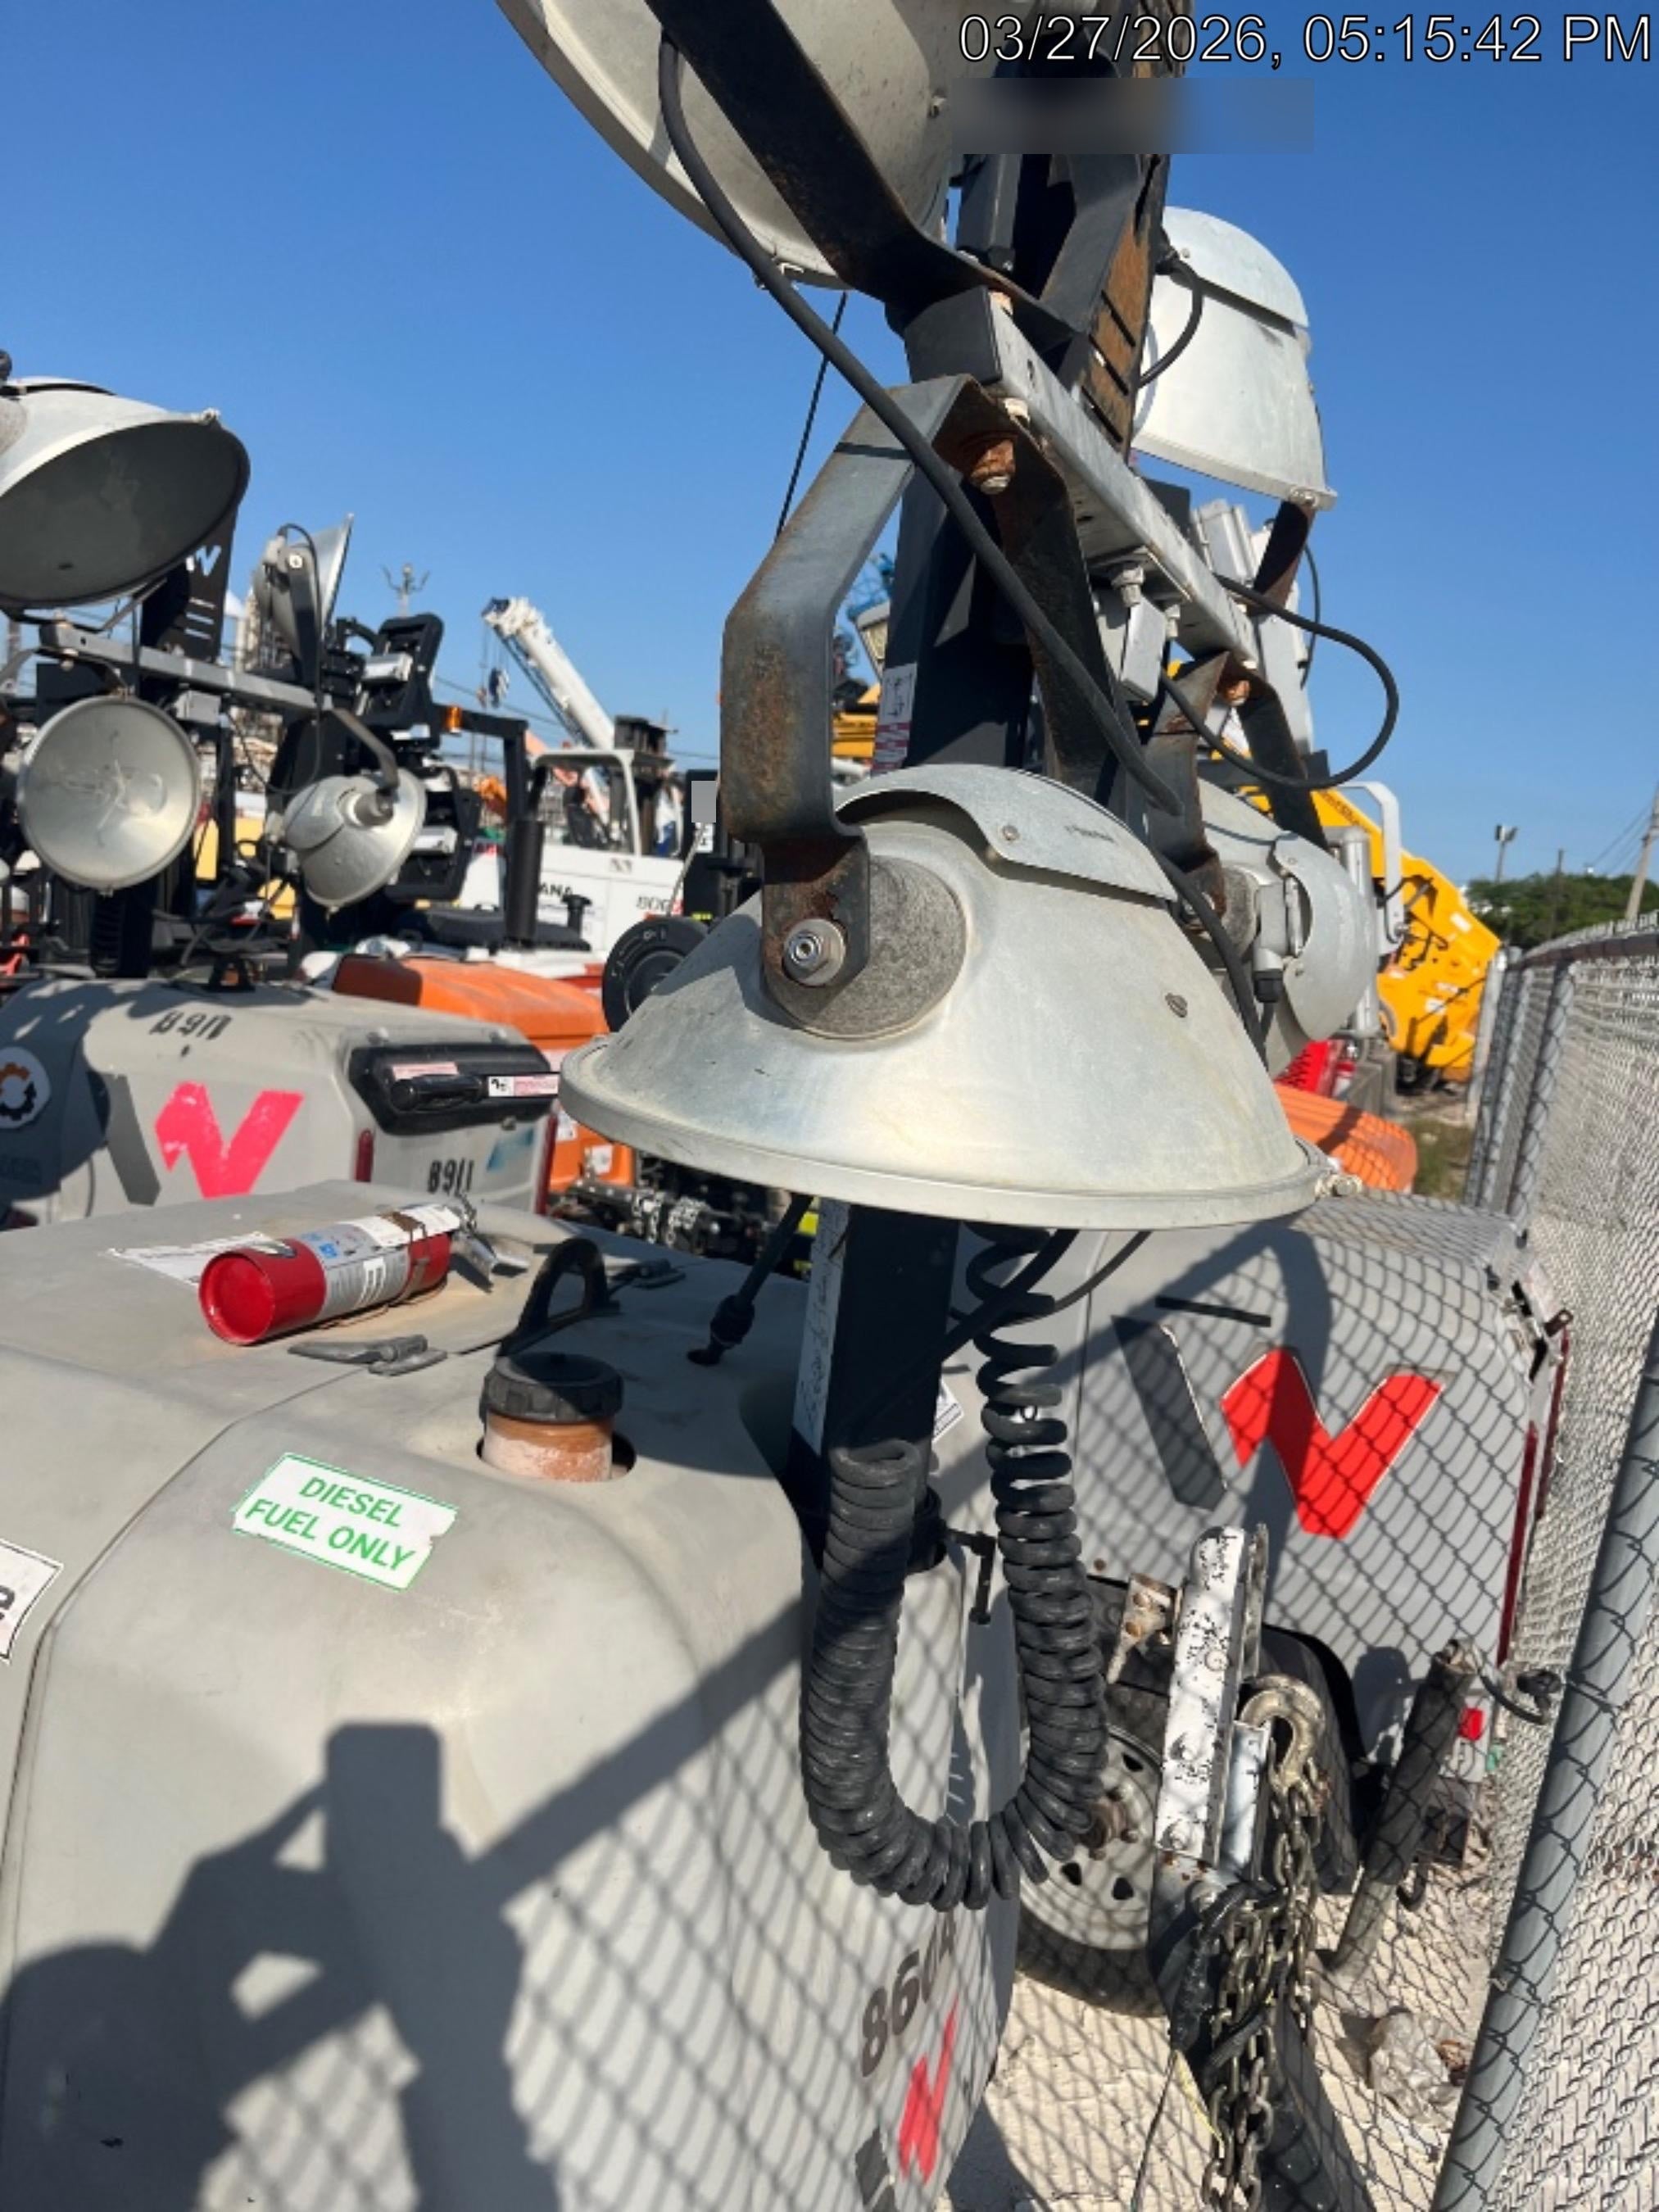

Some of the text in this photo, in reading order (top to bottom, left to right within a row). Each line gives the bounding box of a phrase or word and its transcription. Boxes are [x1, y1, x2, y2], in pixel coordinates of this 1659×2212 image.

[299, 1476, 403, 1527] DIESEL
[245, 1498, 416, 1571] FUEL ONLY
